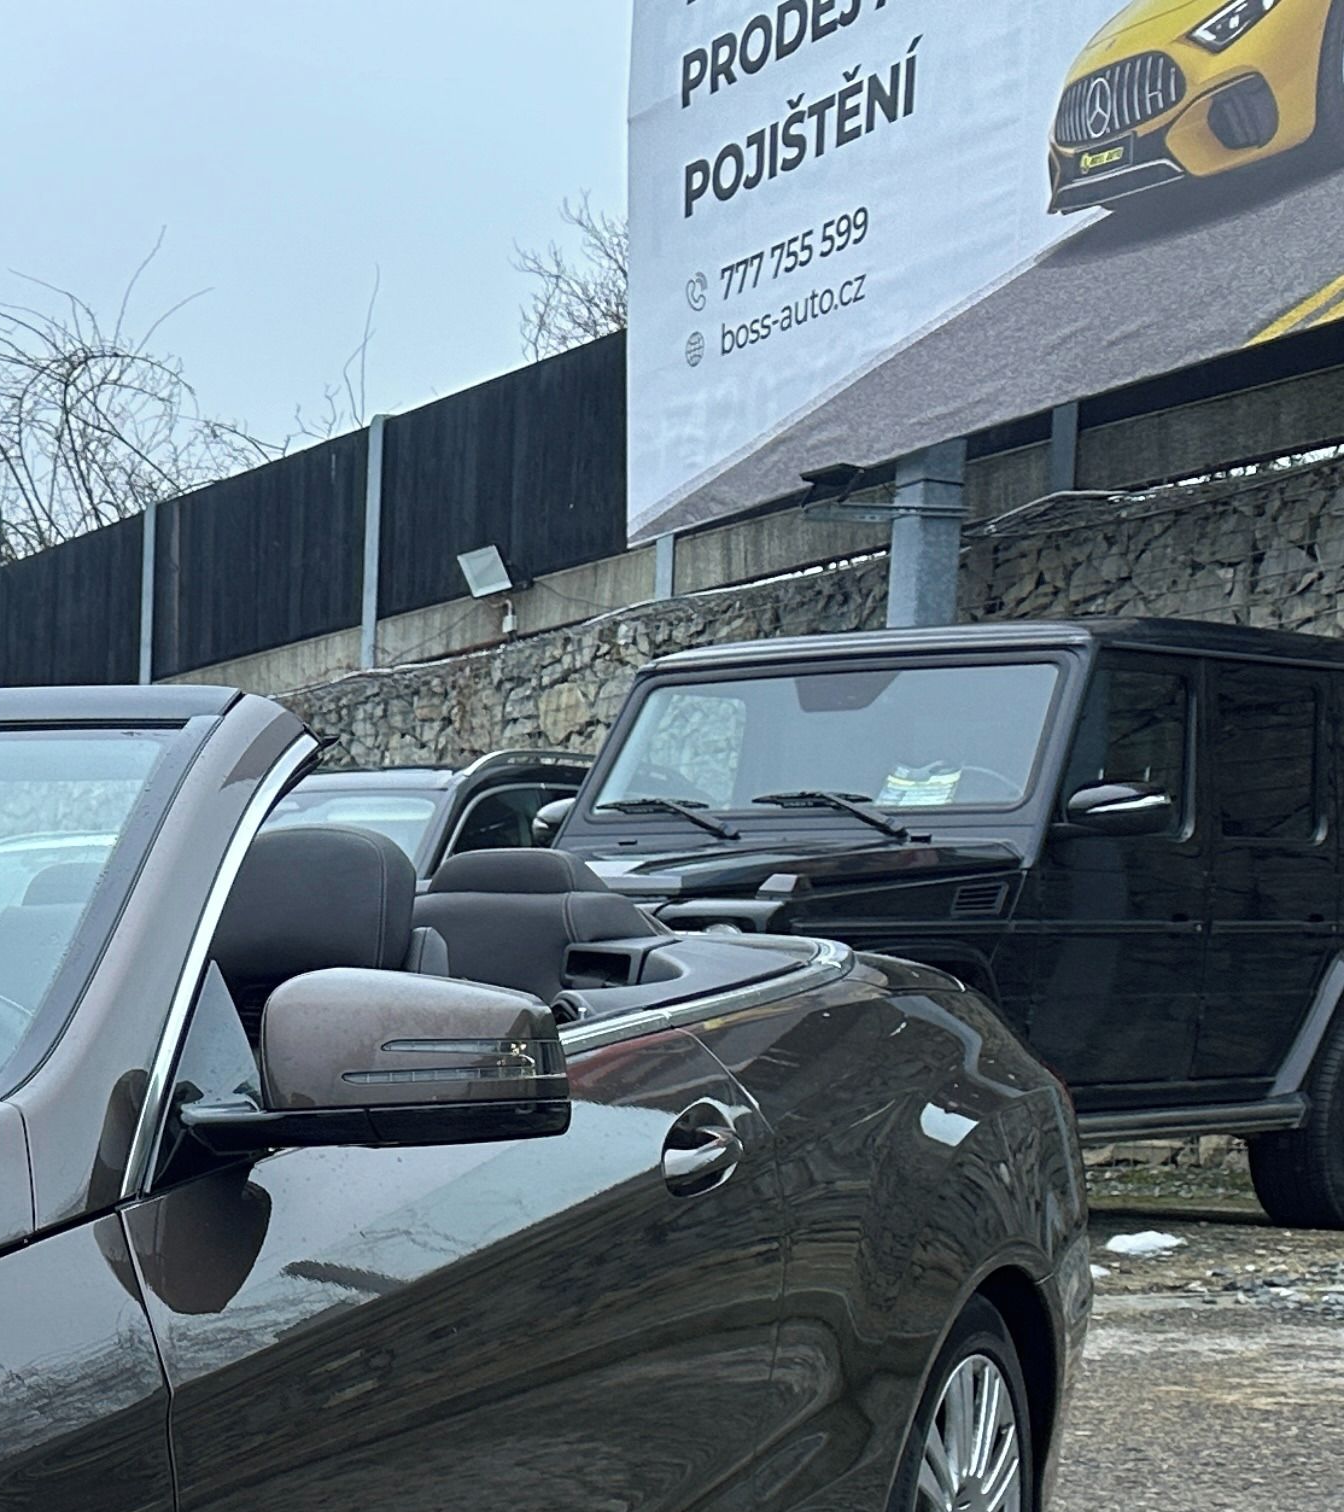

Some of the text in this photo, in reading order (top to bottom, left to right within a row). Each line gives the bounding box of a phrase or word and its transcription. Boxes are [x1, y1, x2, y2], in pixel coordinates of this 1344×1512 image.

[684, 34, 923, 218] POJIŠTĚNÍ
[720, 206, 869, 300] 777 755 599
[719, 274, 867, 356] boss-auto.cz
